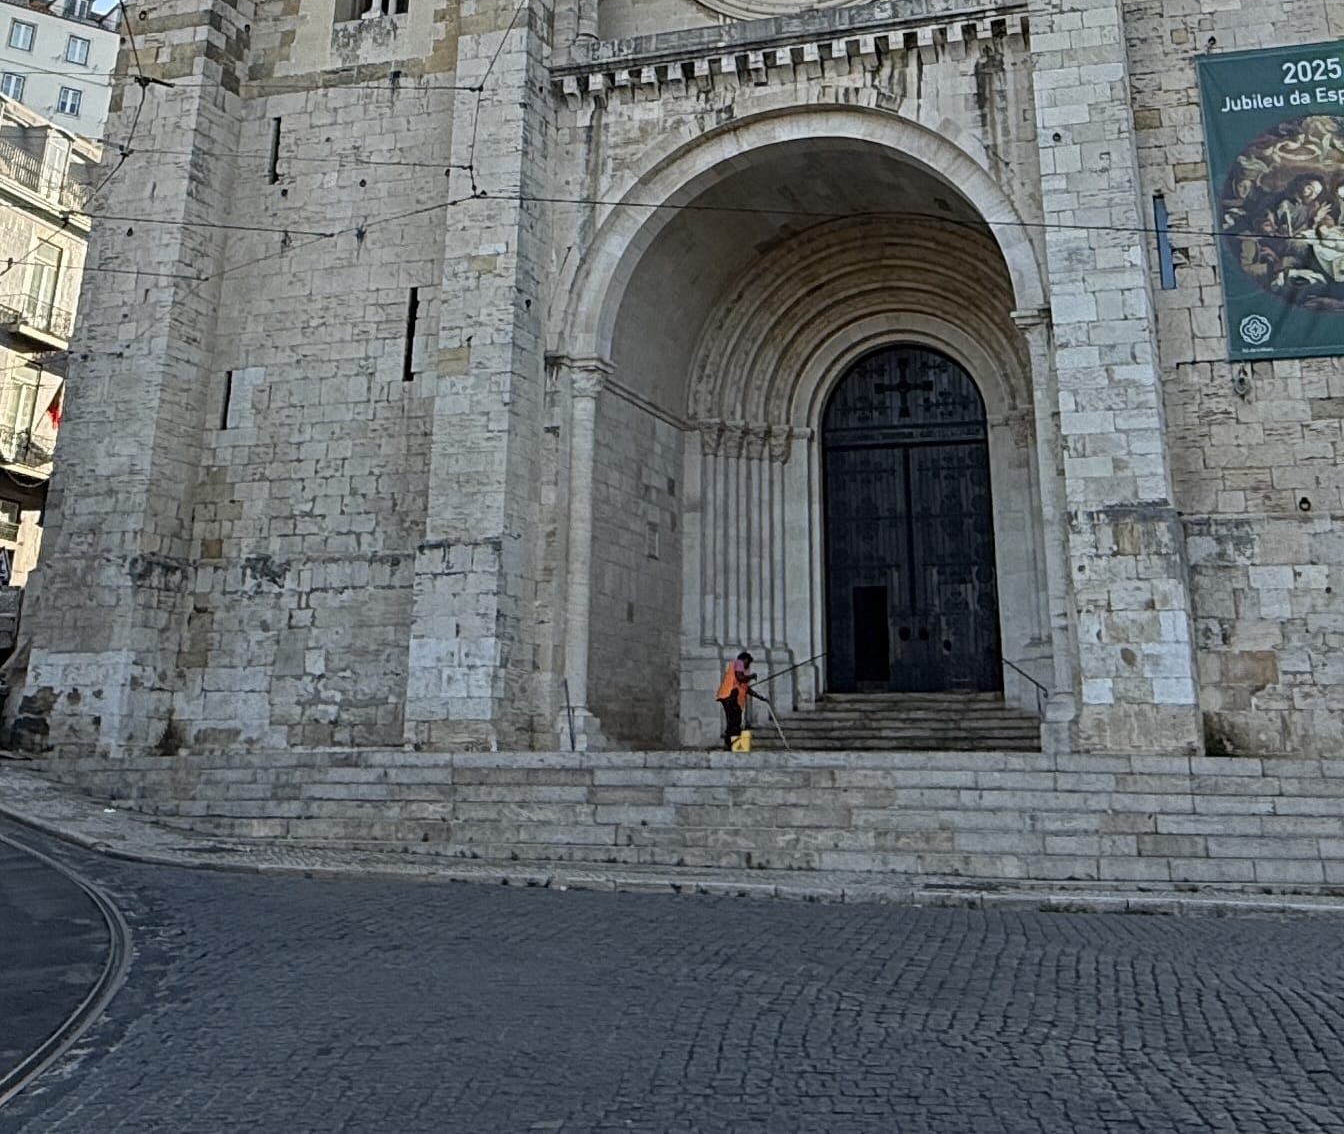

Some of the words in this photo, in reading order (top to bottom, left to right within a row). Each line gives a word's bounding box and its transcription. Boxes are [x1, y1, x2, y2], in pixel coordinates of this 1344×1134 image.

[1282, 57, 1342, 84] 2025
[1221, 93, 1284, 112] Jubileu
[1289, 89, 1311, 105] da
